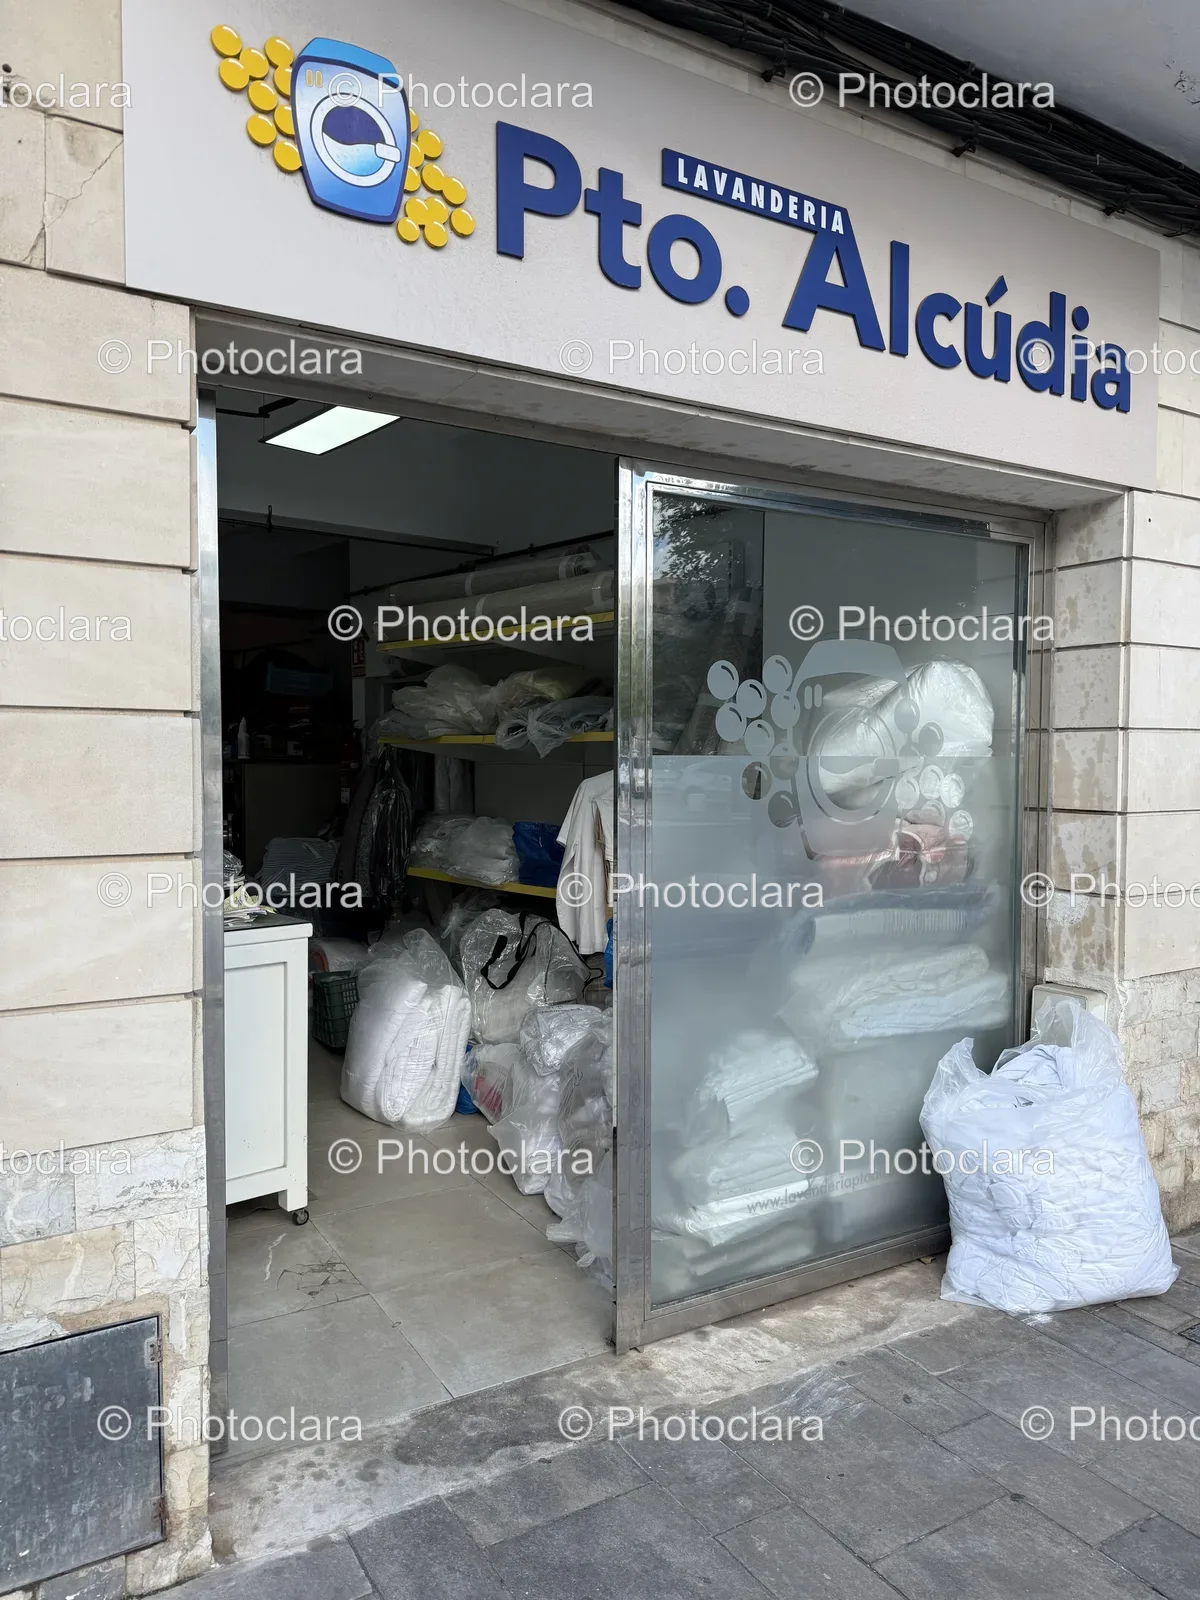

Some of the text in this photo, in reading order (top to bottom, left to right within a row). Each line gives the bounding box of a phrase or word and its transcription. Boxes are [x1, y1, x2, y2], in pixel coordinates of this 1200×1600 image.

[496, 120, 1131, 414] Pto. Alcúdia
[677, 157, 845, 236] LAVANDERIA
